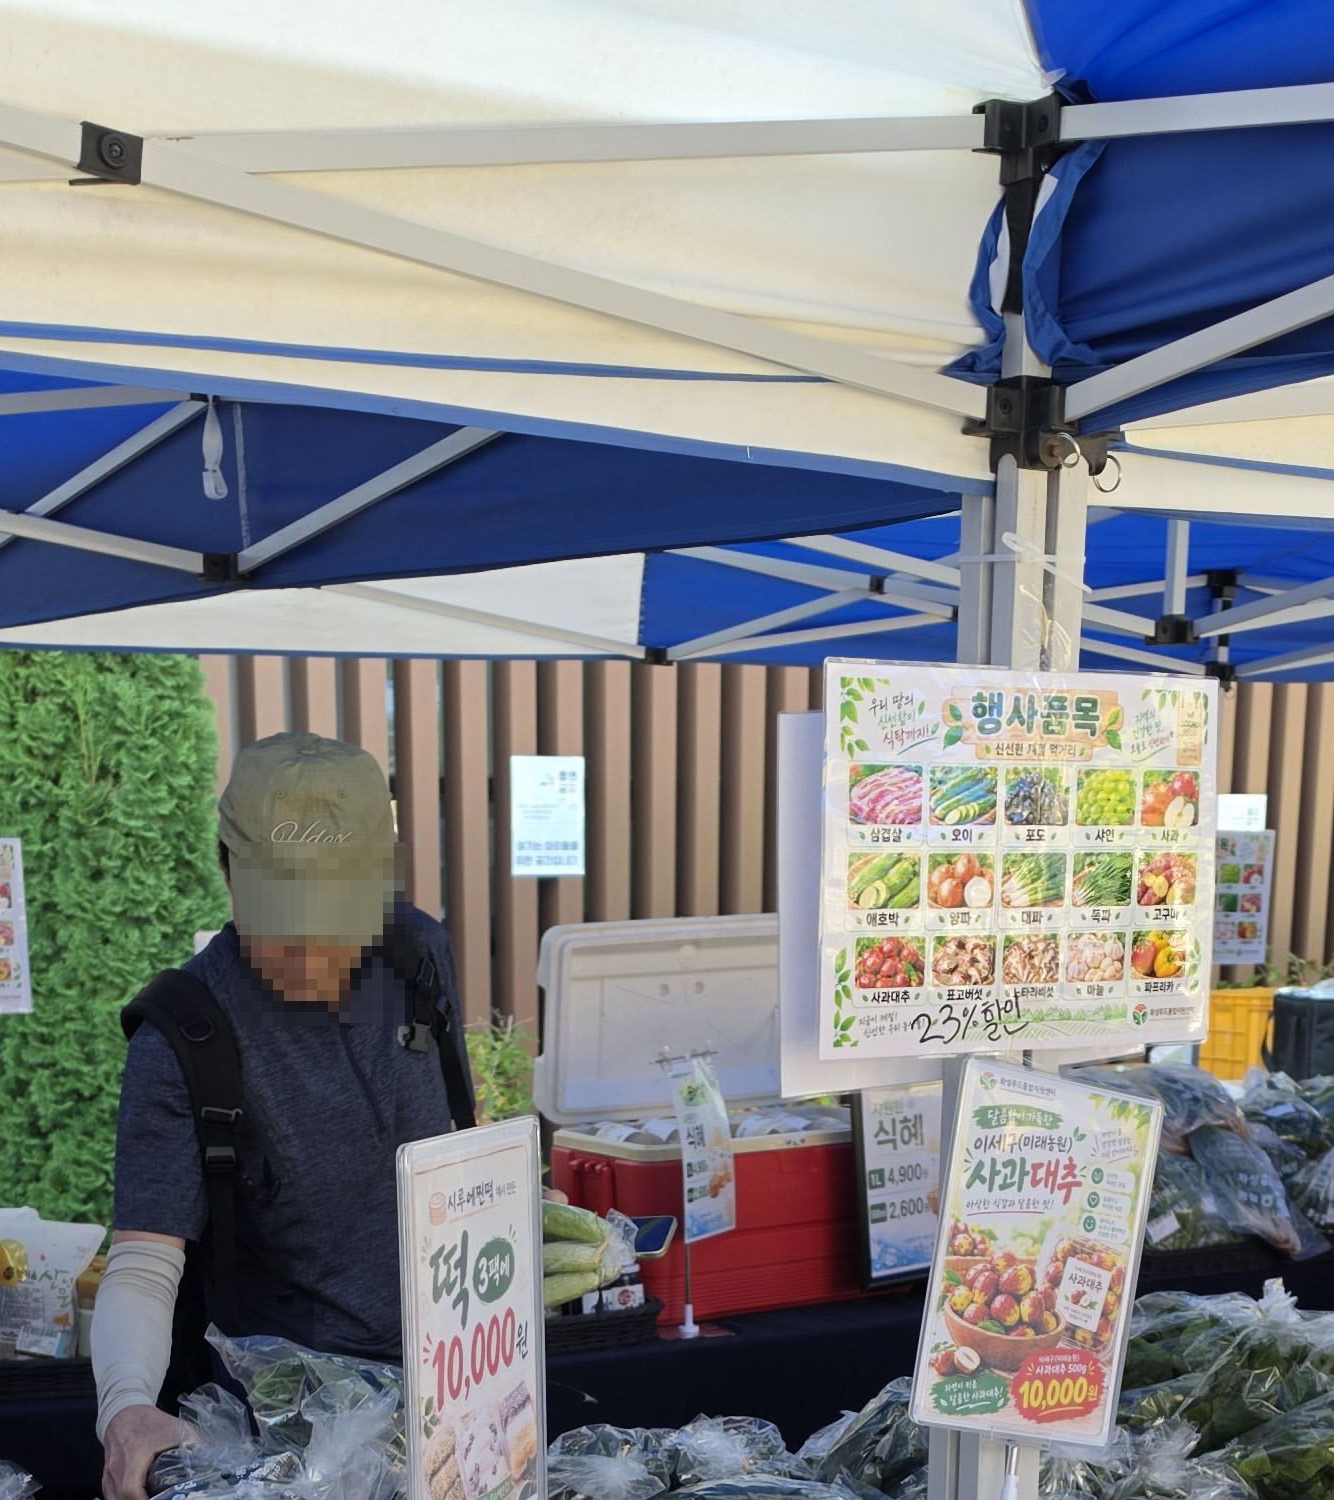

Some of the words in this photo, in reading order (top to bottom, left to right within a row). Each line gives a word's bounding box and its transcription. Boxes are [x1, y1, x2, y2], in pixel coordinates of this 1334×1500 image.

[869, 698, 888, 716] 우리
[892, 692, 914, 710] 땅의
[972, 691, 1100, 737] 행사품목
[883, 724, 930, 749] 식탁까지!
[995, 742, 1024, 757] 신선한
[870, 829, 902, 843] 삼겹살
[952, 829, 973, 843] 오이
[1025, 828, 1046, 842] 포도
[1094, 828, 1115, 843] 샤인
[1160, 828, 1180, 843] 사과
[865, 912, 900, 927] 애호박
[949, 911, 972, 926] 양파
[1151, 908, 1179, 921] 고구마
[946, 988, 984, 1002] 표고버섯
[1086, 983, 1105, 997] 마늘
[1144, 981, 1175, 994] 파프리카
[871, 991, 911, 1005] 사과대추
[874, 1112, 925, 1151] 식혜
[973, 1132, 1073, 1154] 이세구(미래농원)
[870, 1170, 884, 1188] 1L
[965, 1155, 1083, 1206] 사과대추
[429, 1229, 470, 1329] 떡
[478, 1253, 510, 1294] 3팩에
[1068, 1272, 1104, 1293] 사과대추
[1035, 1364, 1066, 1376] 사과대추
[1067, 1364, 1087, 1375] 500g
[971, 1386, 1004, 1401] 사과대추!
[1019, 1376, 1099, 1410] 10,000원
